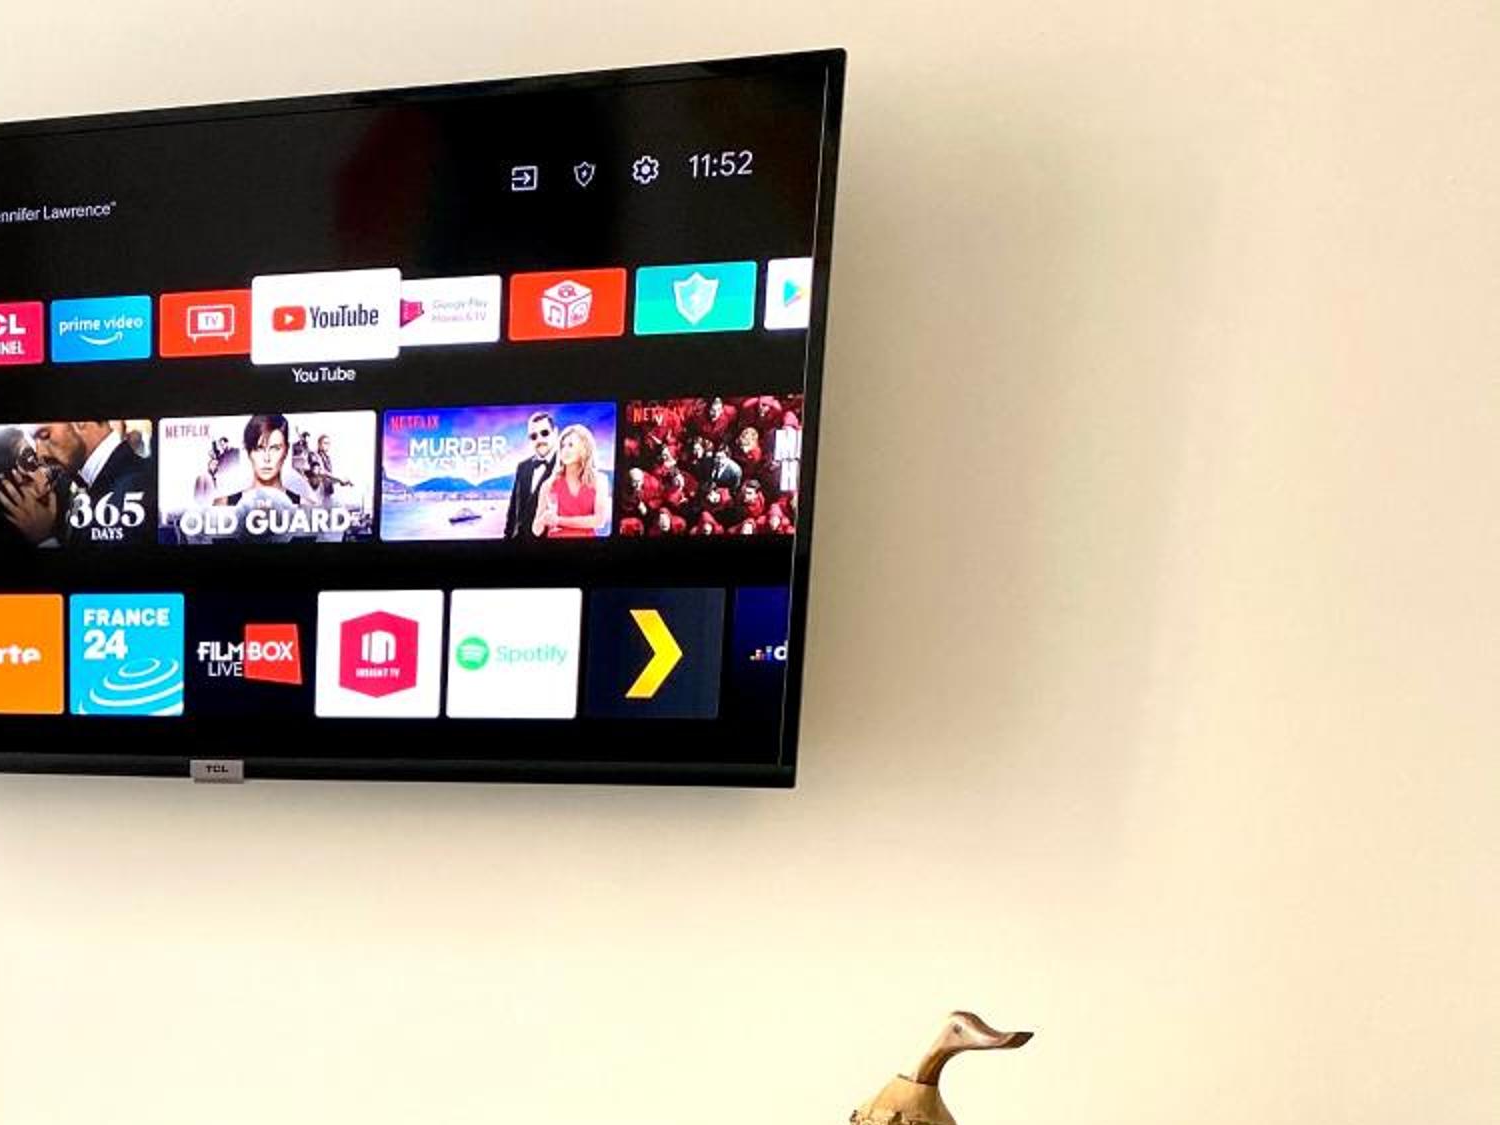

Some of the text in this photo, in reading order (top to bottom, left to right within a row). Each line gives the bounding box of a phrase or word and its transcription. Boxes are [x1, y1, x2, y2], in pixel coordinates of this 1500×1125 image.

[689, 150, 753, 178] 11:52
[43, 201, 117, 220] Lawrence"
[59, 314, 144, 336] prime video
[204, 316, 219, 327] TV
[310, 304, 379, 329] YouTube
[292, 367, 356, 383] YouTube
[165, 424, 211, 439] NETFLIX
[408, 435, 508, 457] MURDER
[69, 491, 145, 529] 365
[180, 507, 351, 536] OLD GUARD
[91, 527, 124, 541] DAYS
[83, 607, 170, 627] FRANCE
[83, 629, 129, 661] 24
[495, 644, 569, 666] Spotify
[207, 661, 243, 677] LIVE
[205, 764, 229, 773] TCL
